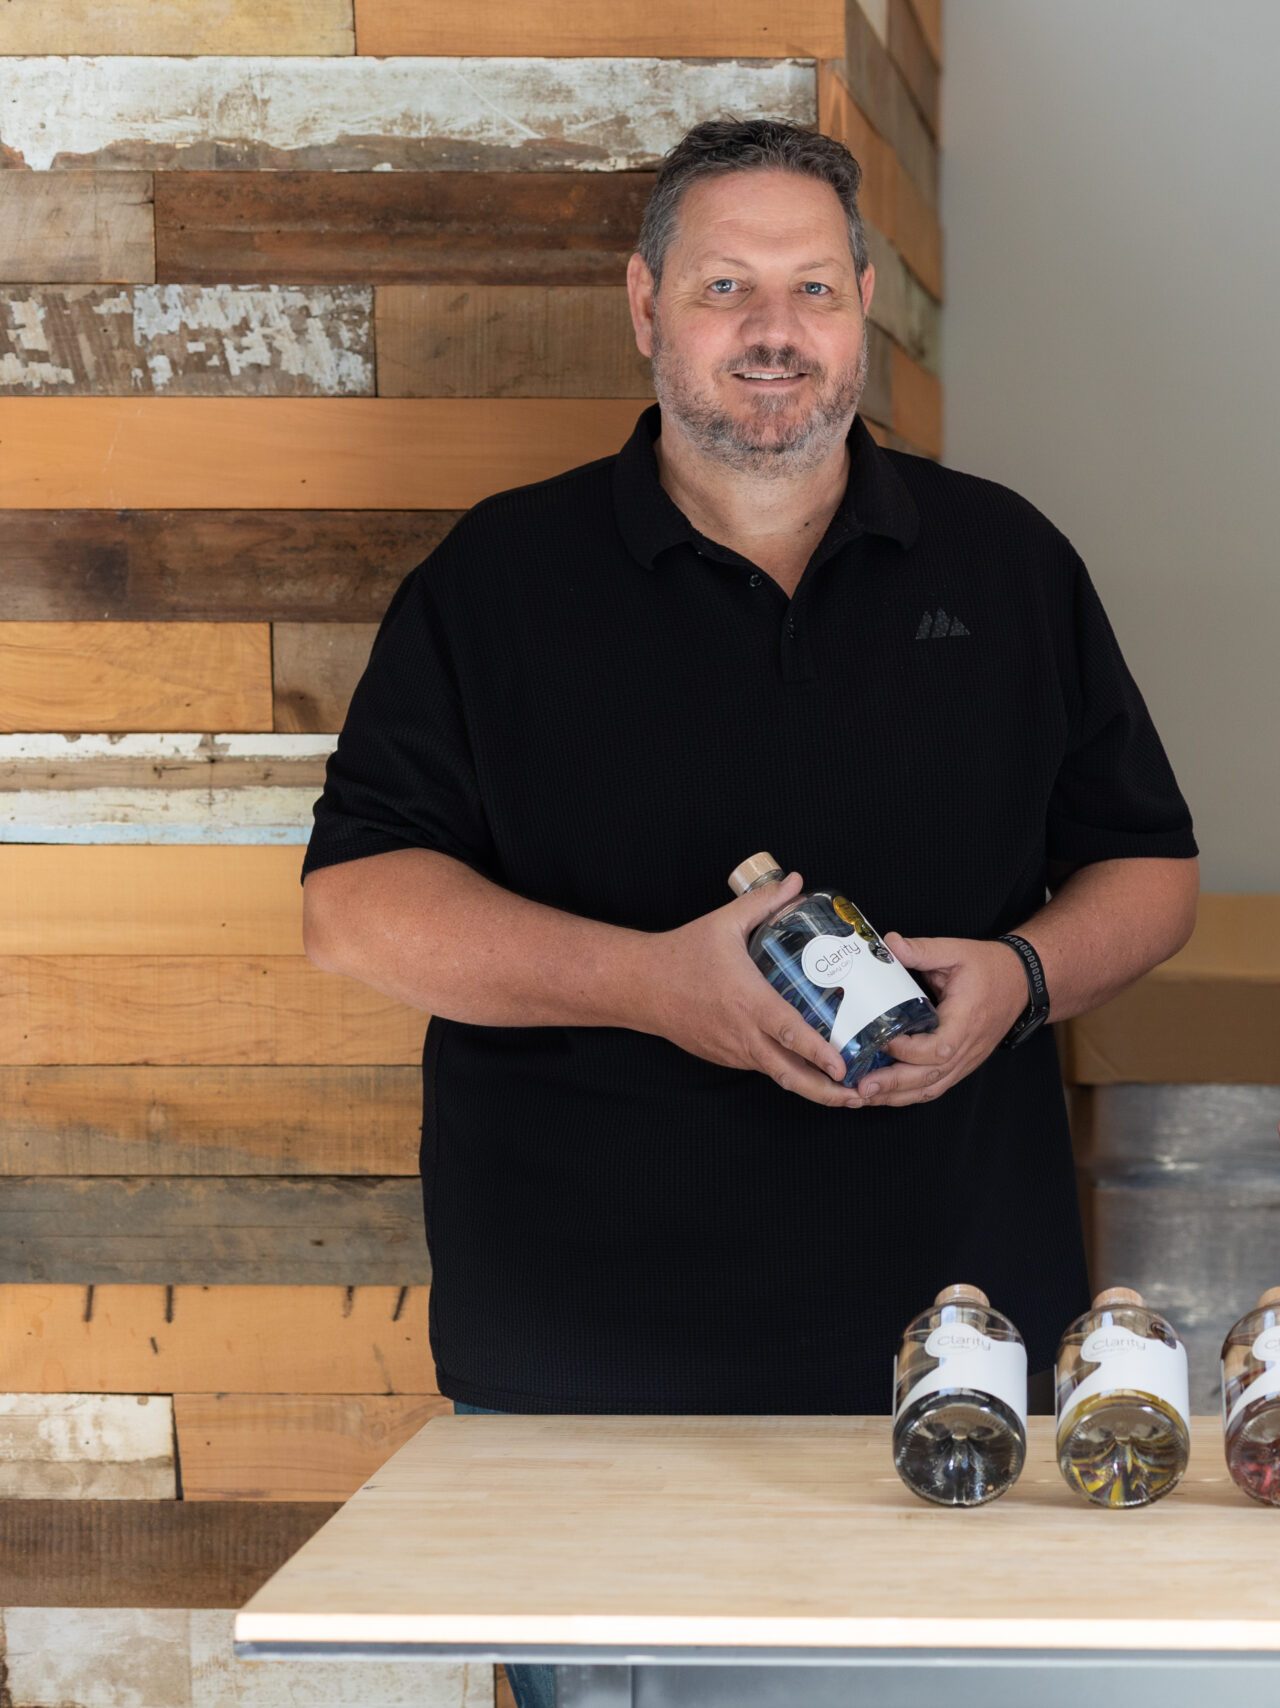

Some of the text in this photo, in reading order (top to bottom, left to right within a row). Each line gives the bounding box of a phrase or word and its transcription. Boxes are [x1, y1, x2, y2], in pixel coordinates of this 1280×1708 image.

[815, 941, 861, 973] Clarity
[937, 1335, 991, 1351] Clarity
[1092, 1336, 1146, 1351] Clarity
